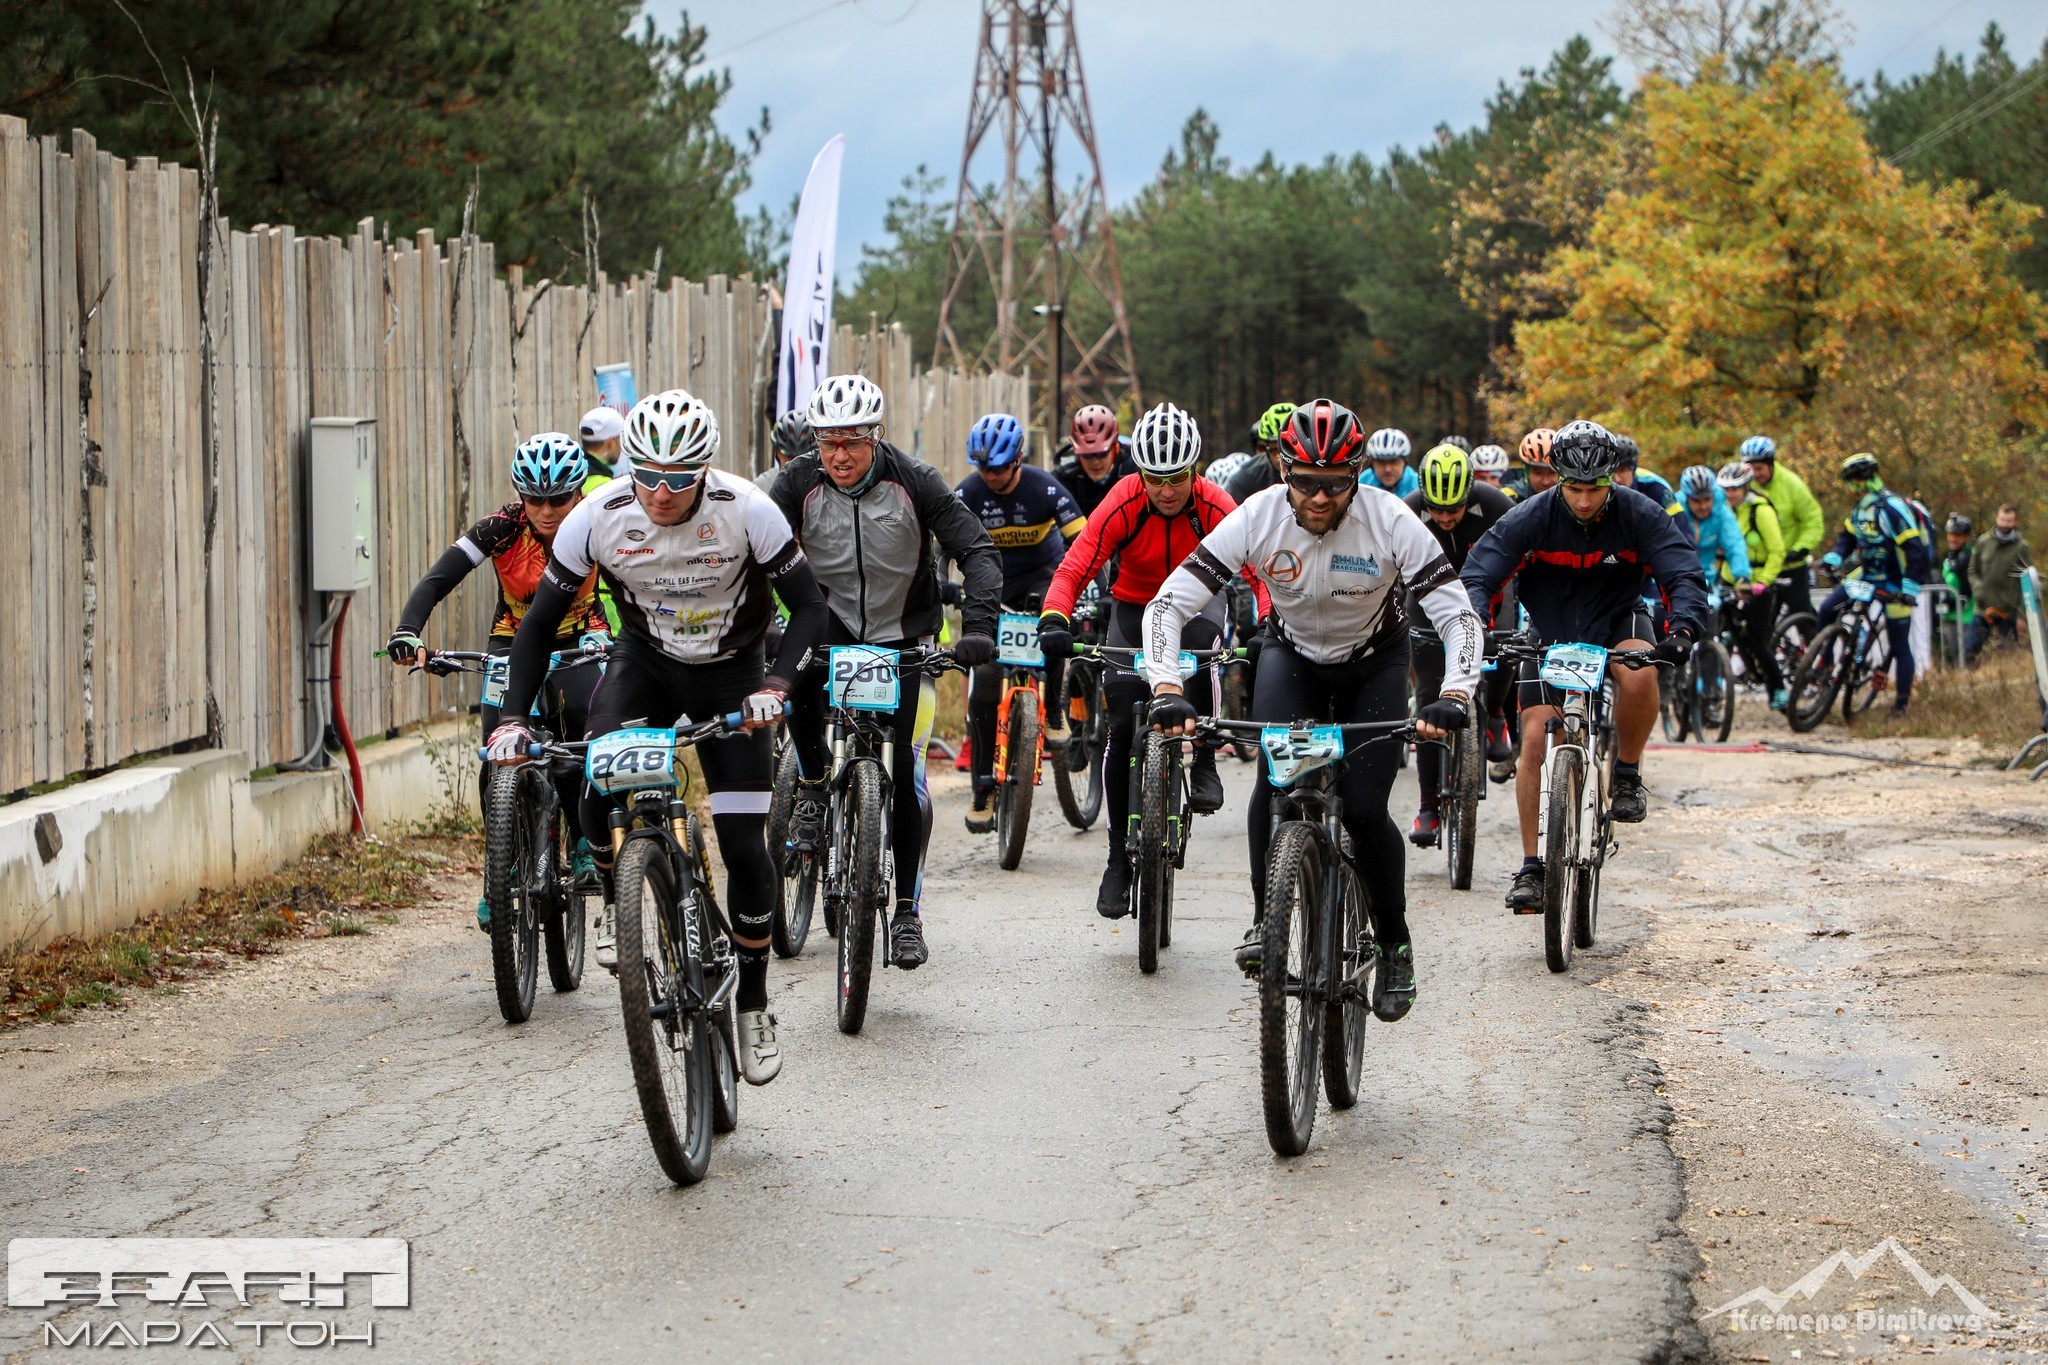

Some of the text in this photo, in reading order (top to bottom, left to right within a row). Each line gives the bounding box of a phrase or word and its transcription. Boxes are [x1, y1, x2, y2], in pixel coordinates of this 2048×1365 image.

[1001, 631, 1040, 648] 207
[835, 661, 893, 683] 250
[592, 750, 666, 779] 248
